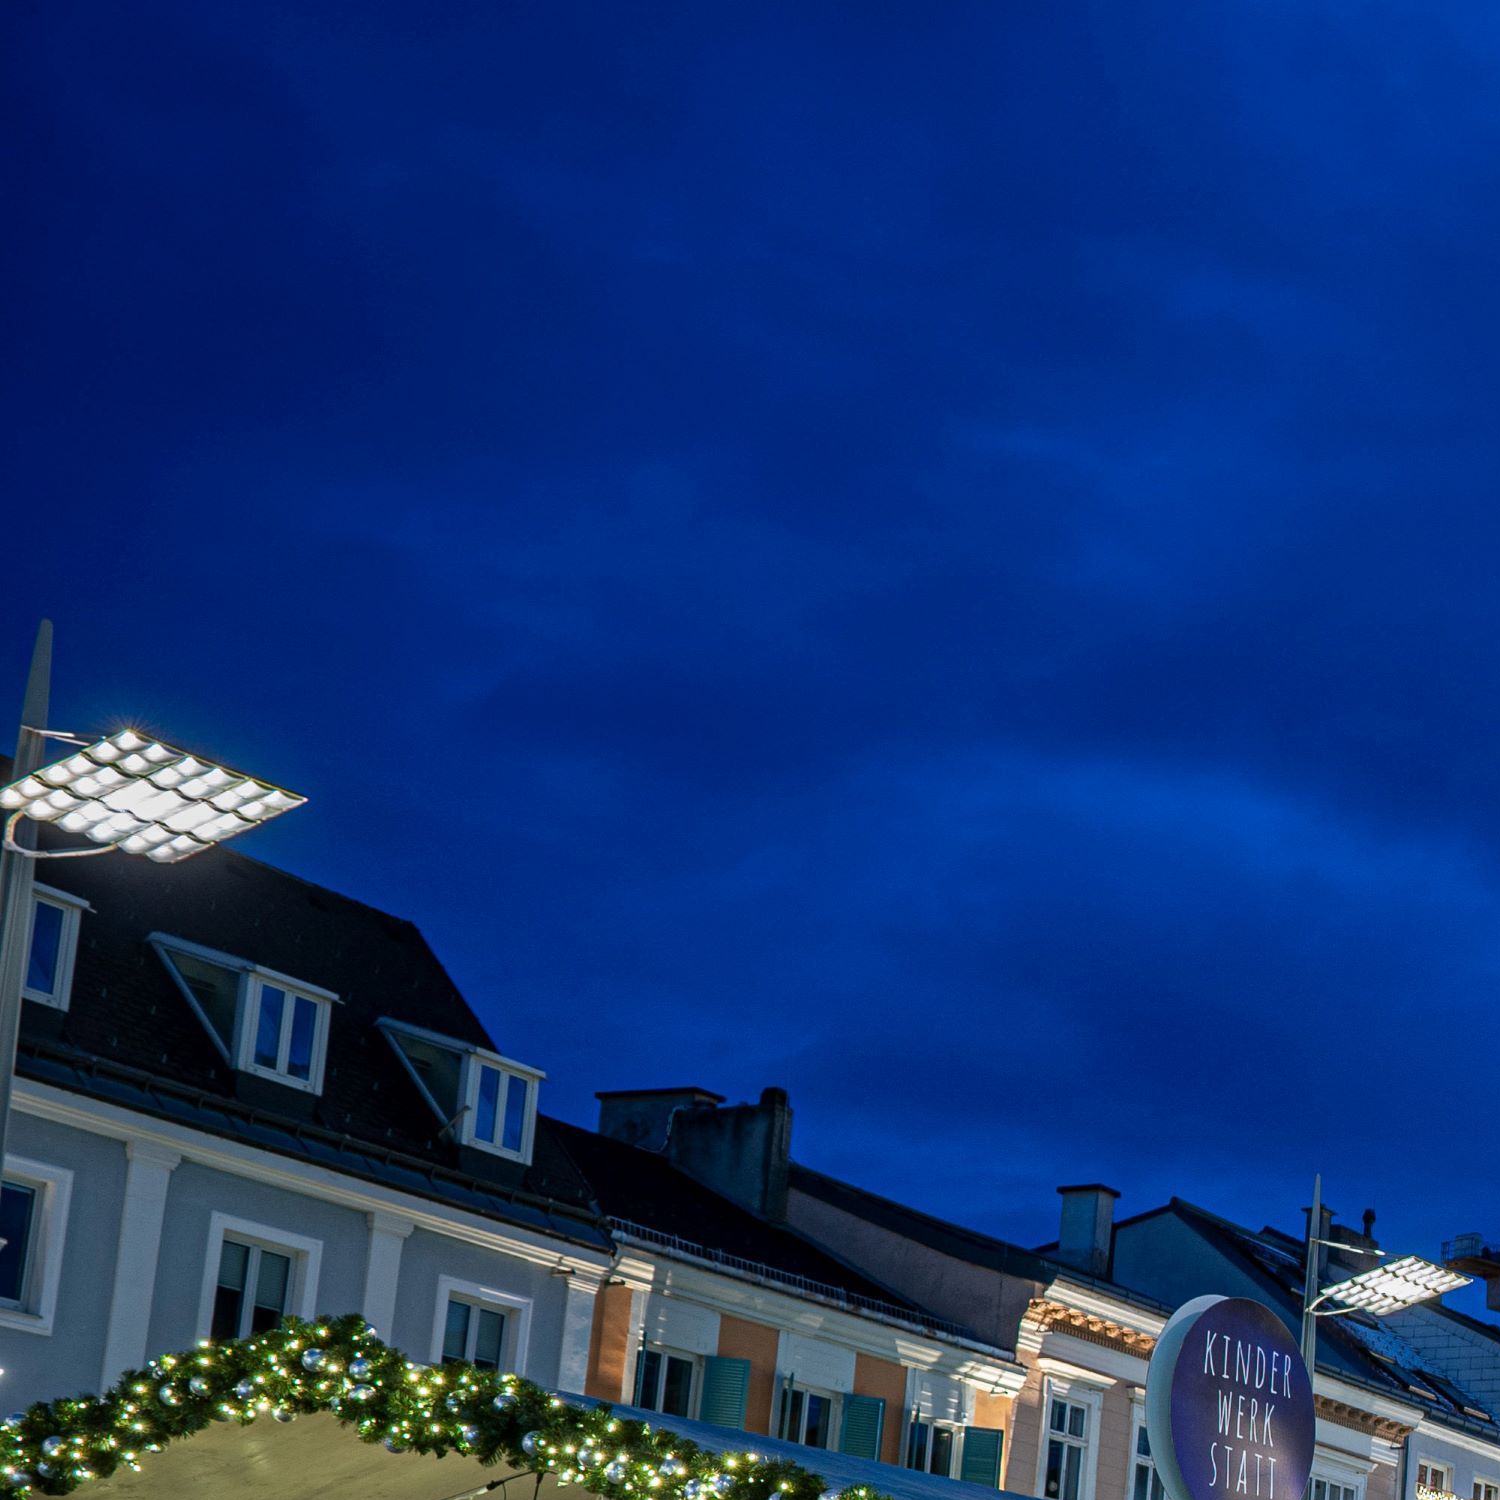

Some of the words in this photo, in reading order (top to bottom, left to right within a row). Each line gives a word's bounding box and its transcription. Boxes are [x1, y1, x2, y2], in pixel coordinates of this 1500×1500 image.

[1203, 1330, 1292, 1399] KINDER
[1216, 1389, 1276, 1447] WERK
[1208, 1442, 1277, 1500] STATT
